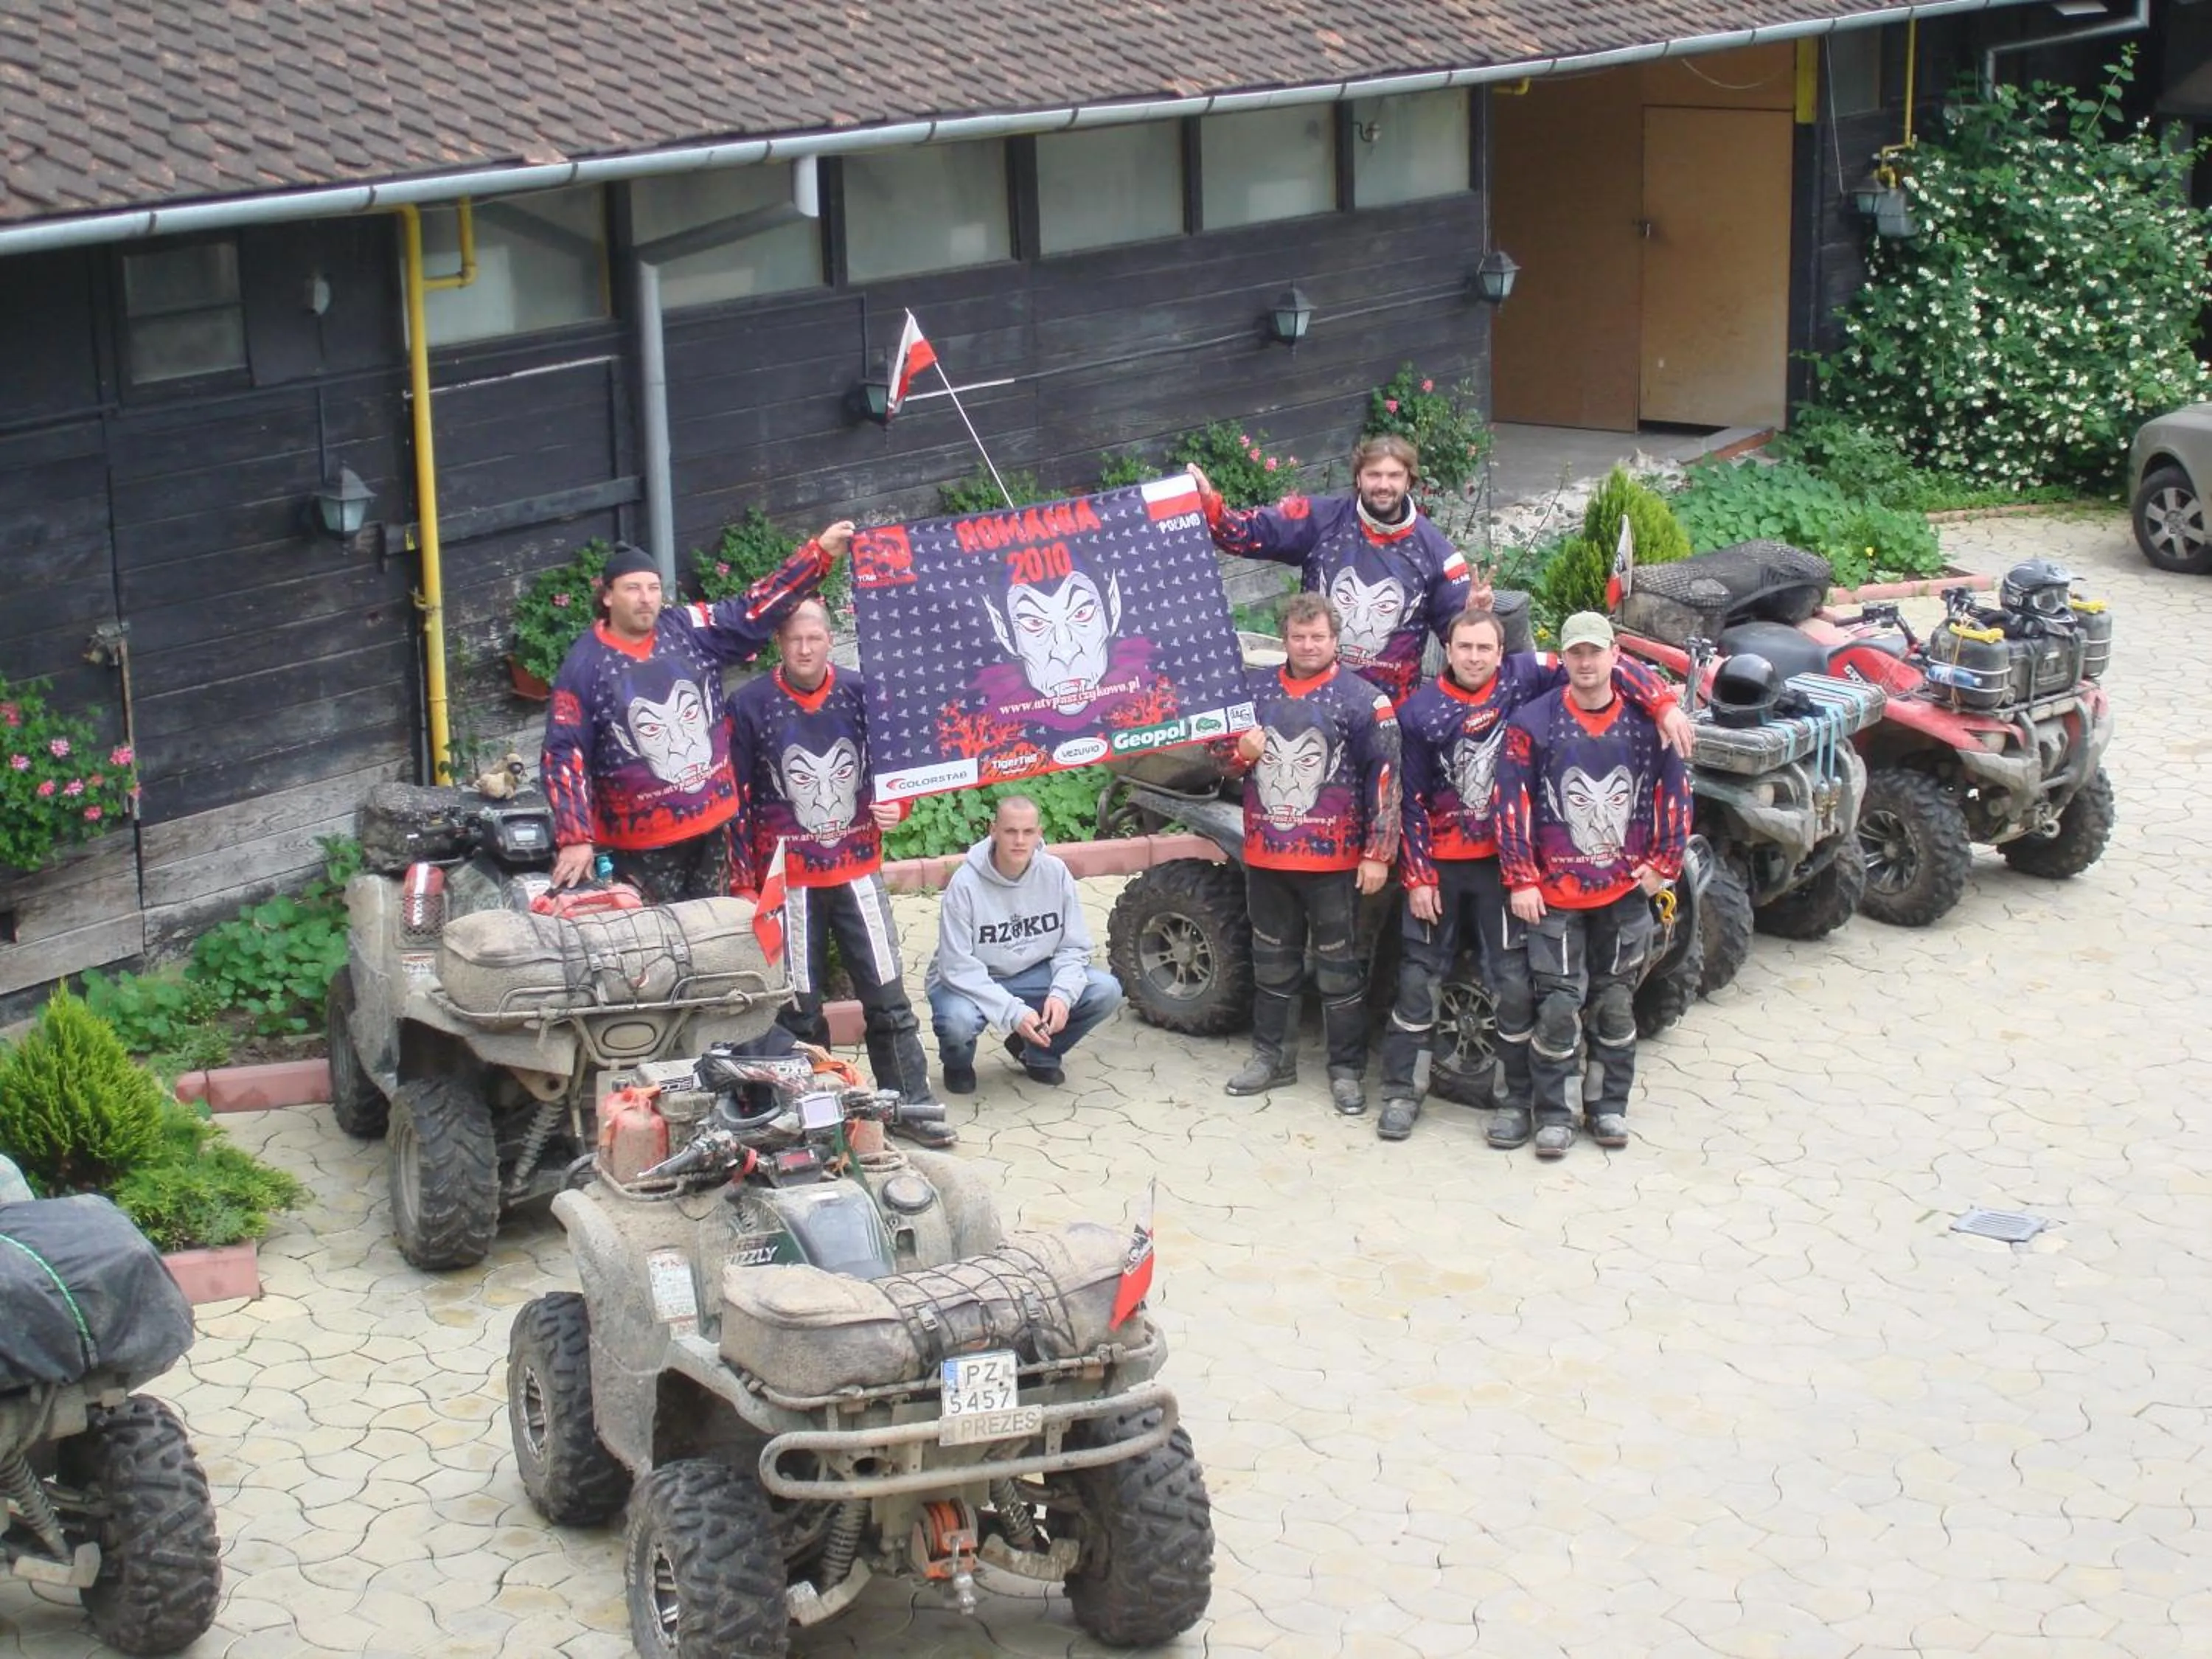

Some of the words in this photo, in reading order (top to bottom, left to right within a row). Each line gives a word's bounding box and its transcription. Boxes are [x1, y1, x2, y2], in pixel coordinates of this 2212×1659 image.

[956, 498, 1102, 553] ROMANIA
[1159, 512, 1201, 534] POLAND
[1005, 541, 1074, 587] 2010
[1114, 720, 1186, 751] Geopol
[723, 1245, 779, 1266] IZZLY
[950, 1386, 1012, 1414] 5457
[960, 1411, 1037, 1439] PREZES
